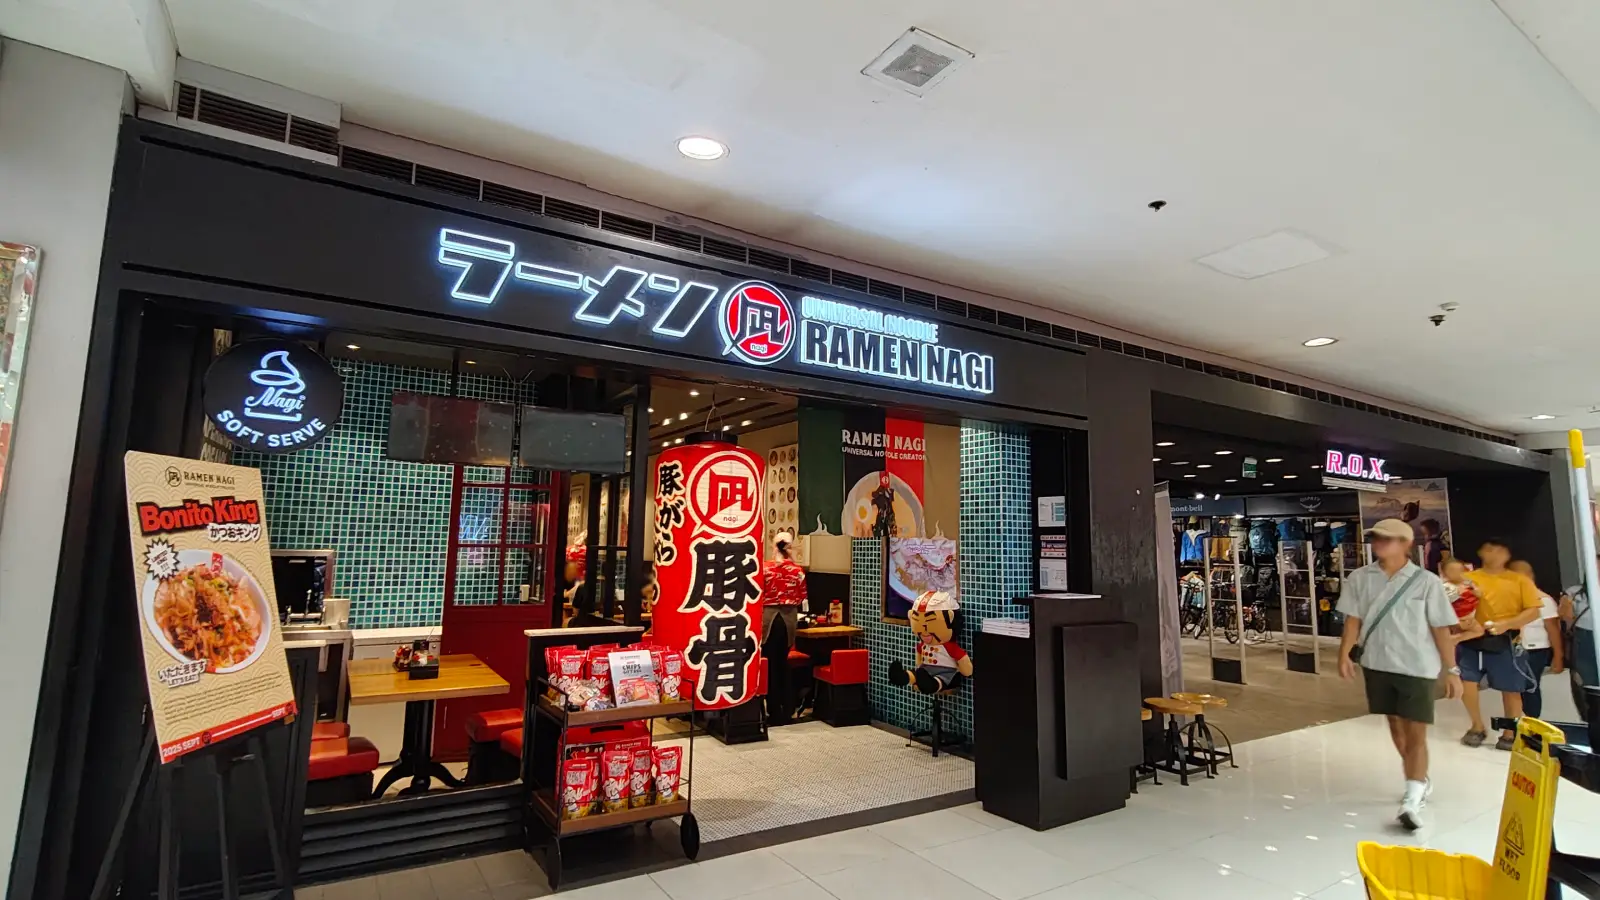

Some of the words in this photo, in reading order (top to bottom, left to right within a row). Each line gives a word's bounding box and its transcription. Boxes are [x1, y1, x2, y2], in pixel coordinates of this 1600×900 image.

[438, 227, 719, 338] ラーメン
[801, 296, 884, 332] UNIVERSAL
[884, 314, 939, 342] NOODLE
[750, 343, 768, 354] nagi
[801, 320, 920, 381] RAMEN
[921, 344, 993, 394] NAGI
[245, 387, 304, 413] Nagi
[217, 410, 264, 443] SOFT
[268, 418, 326, 447] SERVE
[841, 429, 891, 448] RAMEN
[894, 435, 926, 451] NAGI
[841, 446, 874, 457] UNIVERSAL
[184, 471, 214, 482] RAMEN
[216, 474, 235, 485] NAGI
[1326, 449, 1390, 481] R.O.X.
[138, 501, 214, 533] Bonito
[212, 498, 259, 524] King
[655, 461, 686, 565] 豚がら
[723, 515, 739, 523] nagi
[210, 525, 260, 539] かつおキング
[682, 538, 761, 703] 豚骨
[157, 660, 205, 680] いただきます
[1511, 771, 1536, 799] CAUTION
[1499, 856, 1521, 881] FLOOR
[1504, 847, 1519, 864] WET
